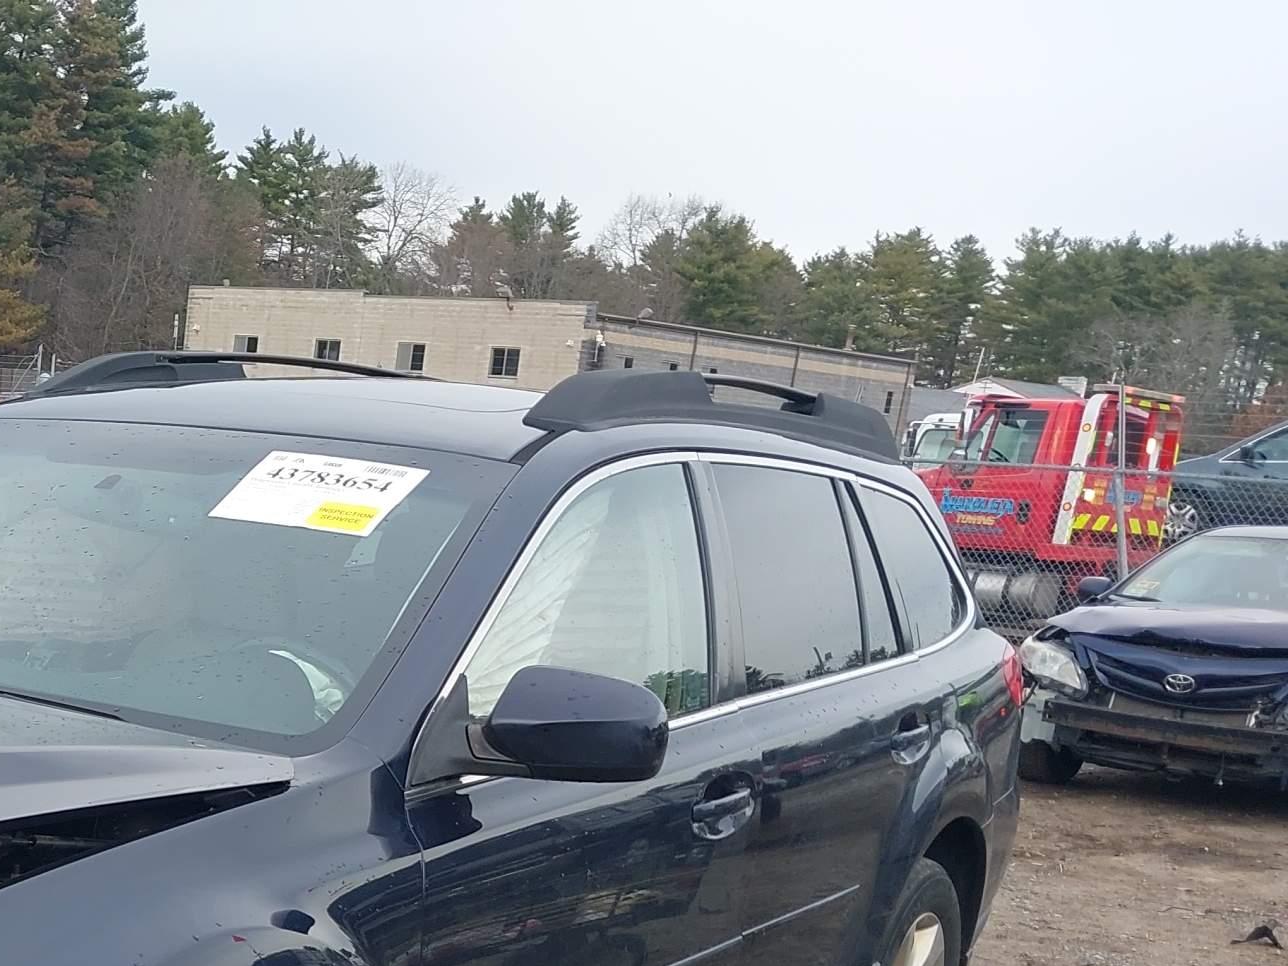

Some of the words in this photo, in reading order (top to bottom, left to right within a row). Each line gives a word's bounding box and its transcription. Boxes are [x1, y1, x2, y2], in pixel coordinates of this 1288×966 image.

[266, 466, 394, 493] 43783654
[319, 506, 376, 519] INSPECTION
[320, 514, 362, 524] SERVICE
